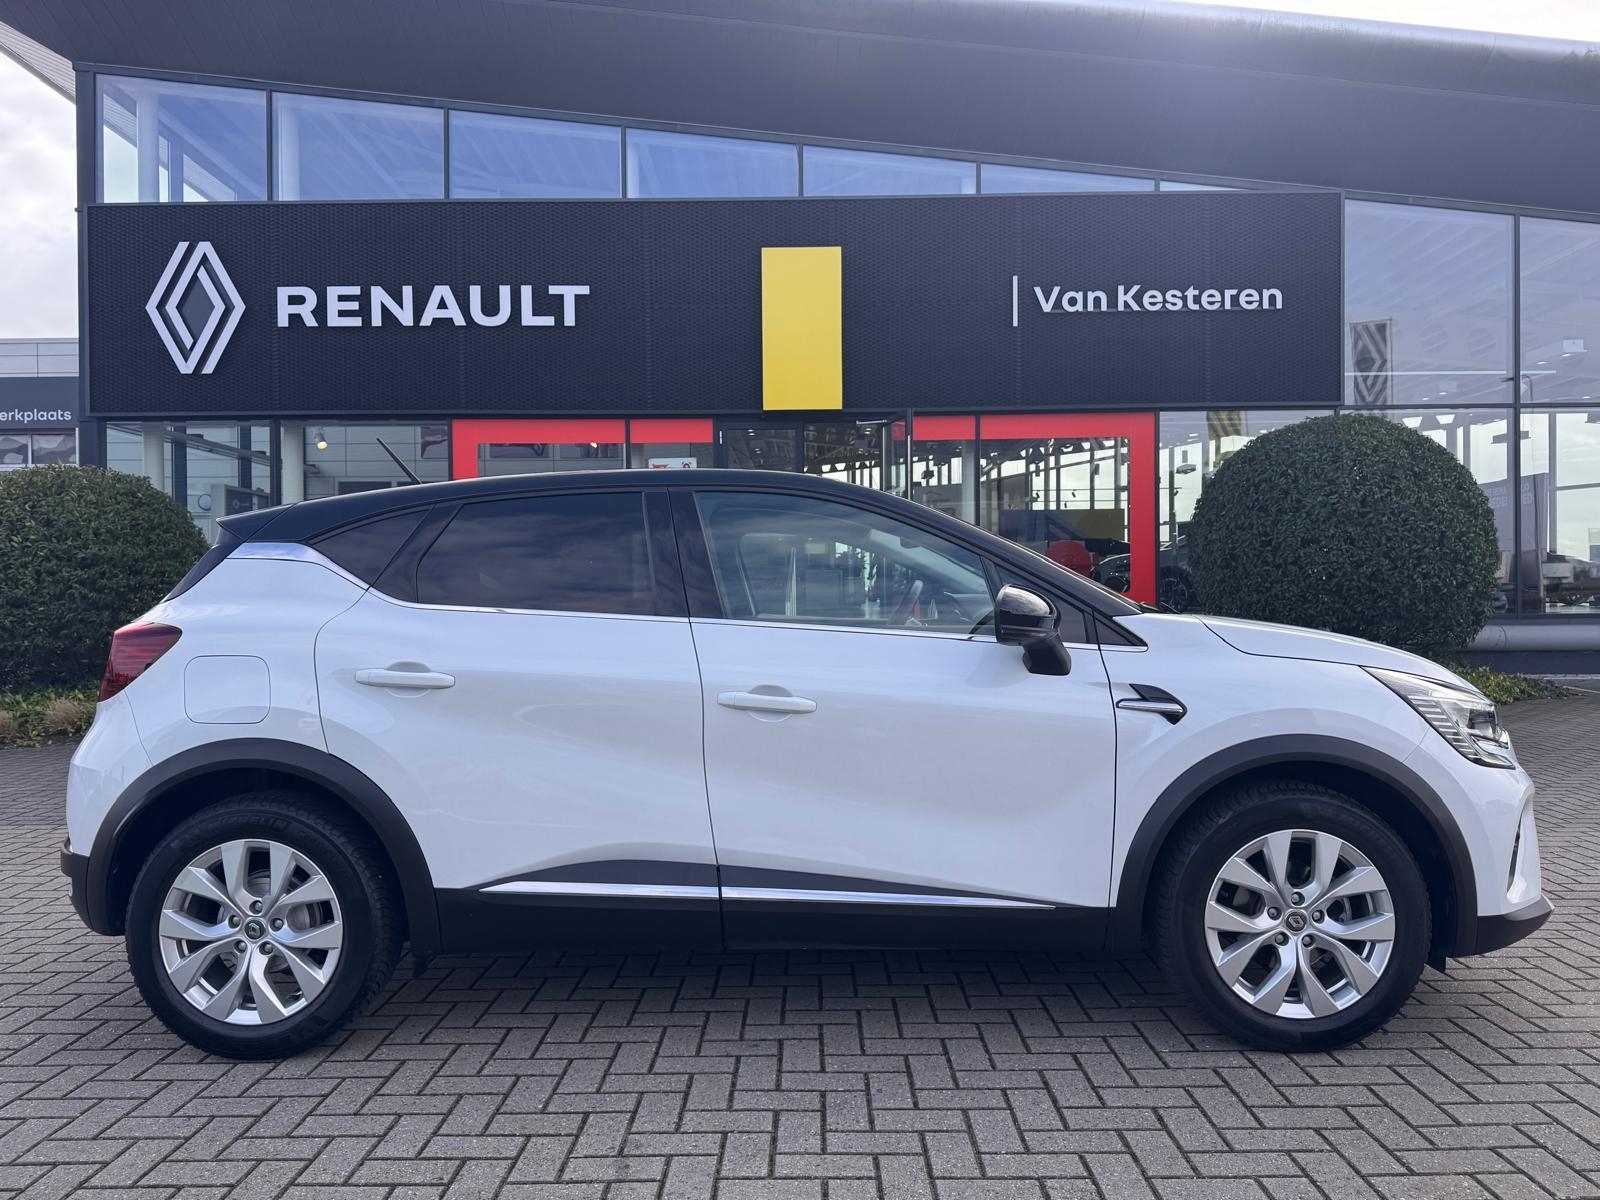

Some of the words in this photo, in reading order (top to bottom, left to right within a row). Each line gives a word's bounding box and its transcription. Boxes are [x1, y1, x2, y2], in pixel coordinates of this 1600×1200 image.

[277, 284, 590, 328] RENAULT
[1033, 286, 1108, 314] Van
[1117, 284, 1284, 313] Kesteren
[0, 408, 72, 424] erkplaats
